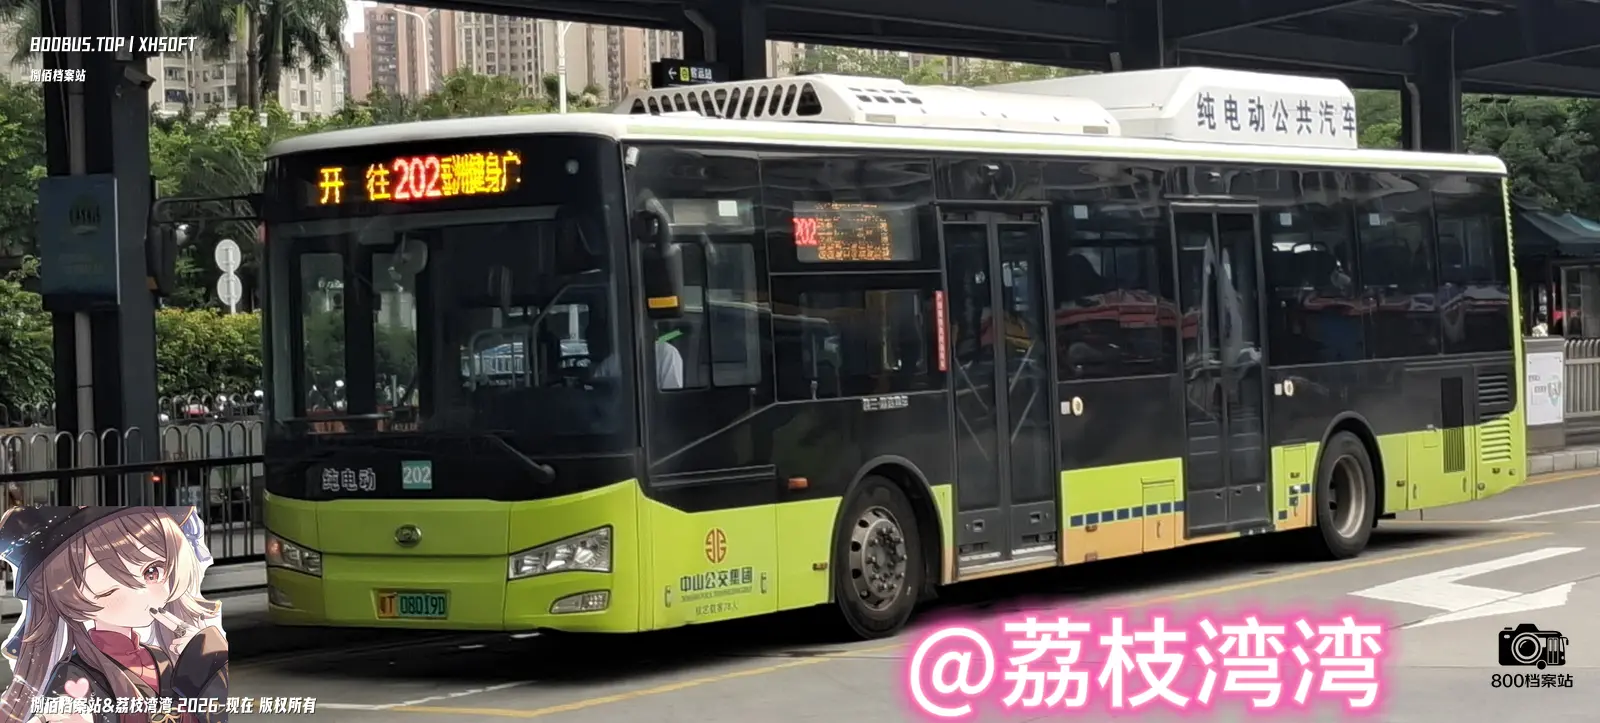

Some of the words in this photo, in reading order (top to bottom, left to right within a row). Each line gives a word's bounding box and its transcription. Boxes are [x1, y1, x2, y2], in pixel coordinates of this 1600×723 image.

[1197, 92, 1355, 138] 纯电动公共汽车
[394, 156, 442, 199] 202
[793, 217, 819, 245] 202
[322, 467, 377, 491] 纯电动
[402, 466, 431, 484] 202
[680, 567, 752, 592] 中山公交集团
